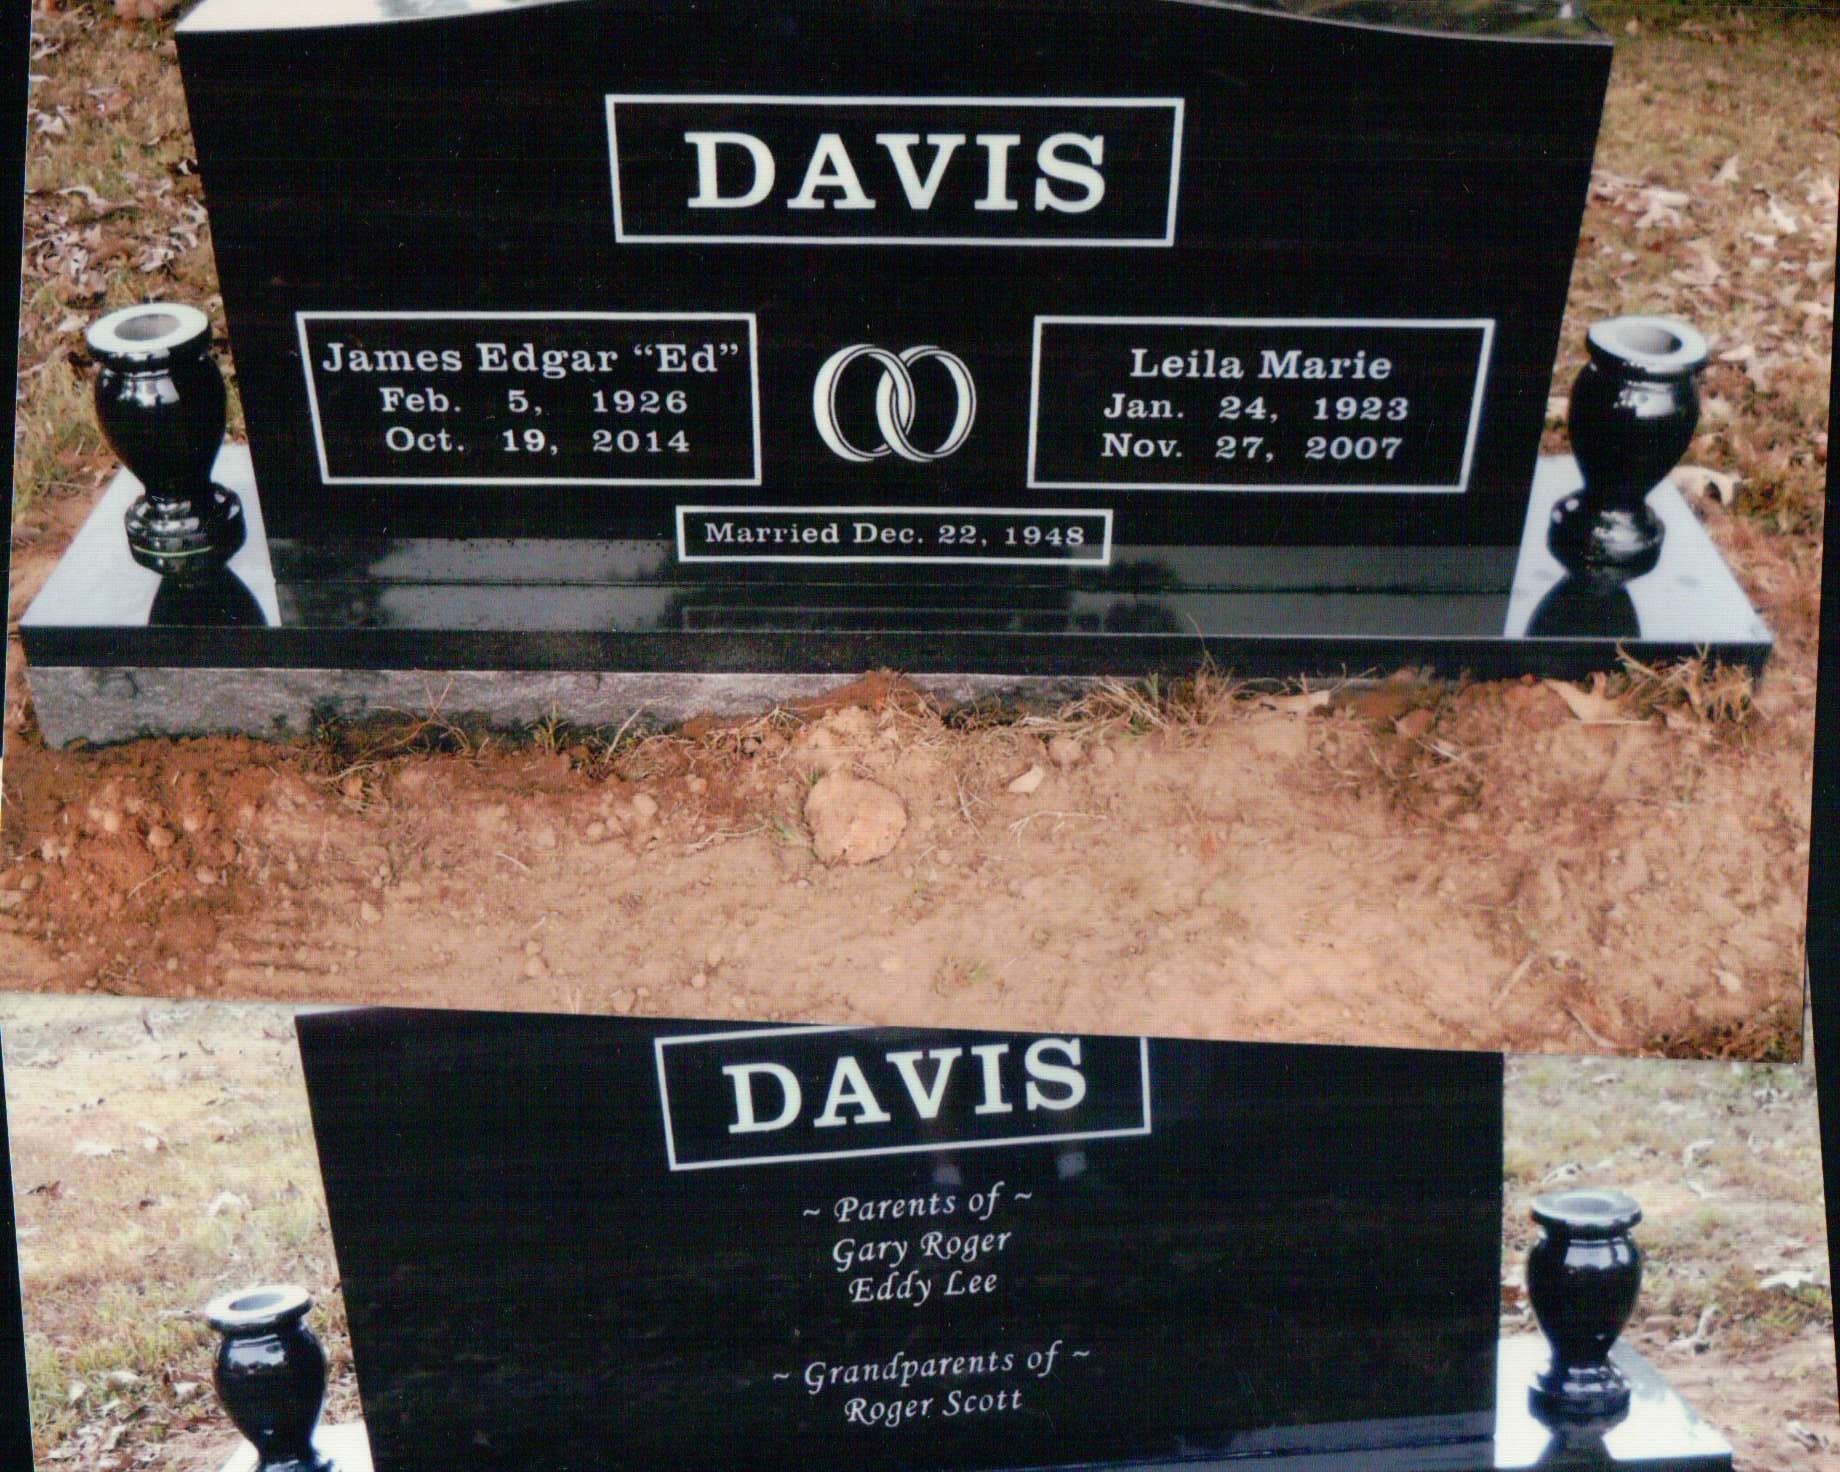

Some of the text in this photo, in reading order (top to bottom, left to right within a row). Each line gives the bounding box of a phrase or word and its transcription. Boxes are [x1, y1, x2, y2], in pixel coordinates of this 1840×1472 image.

[684, 131, 1107, 213] DAVIS
[322, 342, 463, 373] James
[475, 342, 618, 380] Edgar
[1130, 348, 1393, 380] Leila Marie
[379, 387, 688, 415] Feb. 5, 1926
[1103, 392, 1409, 423] Jan. 24, 1923
[385, 426, 690, 456] Oct. 19, 2014
[1100, 432, 1403, 462] Nov. 27, 2007
[703, 521, 1085, 547] Married Dec. 22, 1948
[721, 1036, 1088, 1135] DAVIS
[832, 1192, 957, 1224] Parents
[968, 1181, 1005, 1222] of
[832, 1230, 1013, 1273] Gary Roger
[847, 1269, 999, 1308] Eddy Lee
[804, 1350, 1015, 1395] Grandparents
[1025, 1339, 1063, 1378] of
[843, 1389, 1023, 1428] Roger Scott
